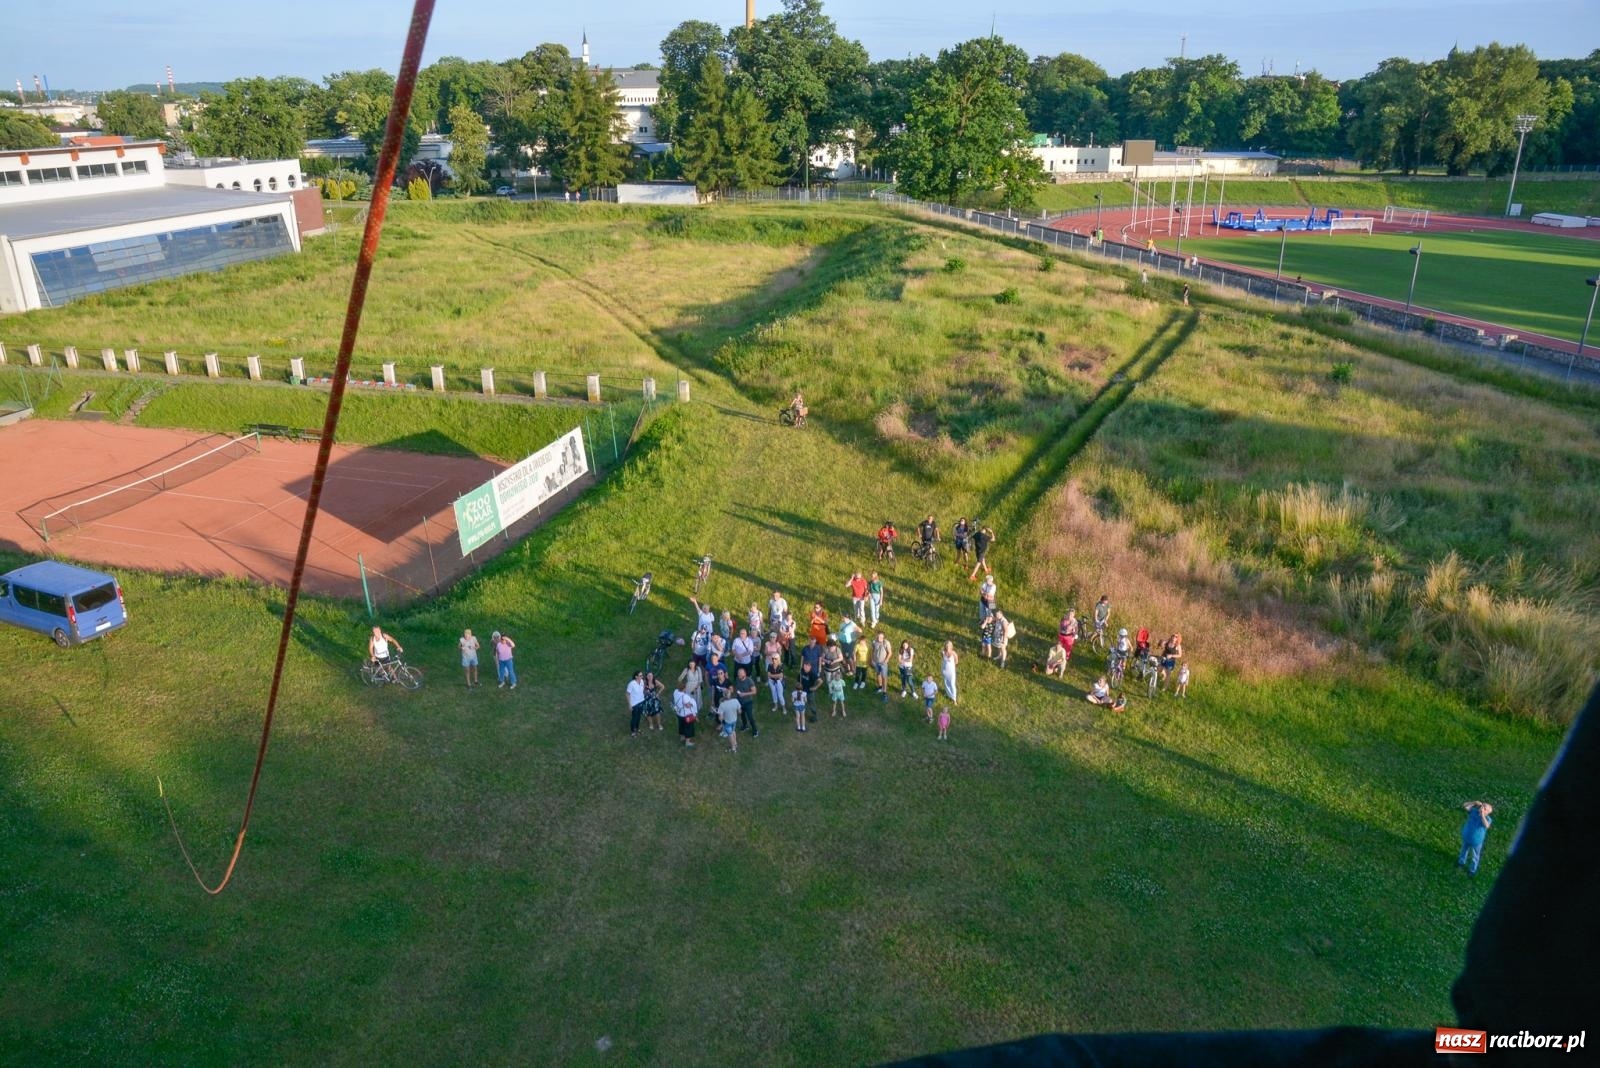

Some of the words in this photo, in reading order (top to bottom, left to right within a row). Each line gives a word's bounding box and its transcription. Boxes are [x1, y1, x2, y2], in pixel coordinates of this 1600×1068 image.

[522, 463, 532, 476] DLA
[473, 494, 491, 514] ZOO
[472, 505, 492, 524] MAR
